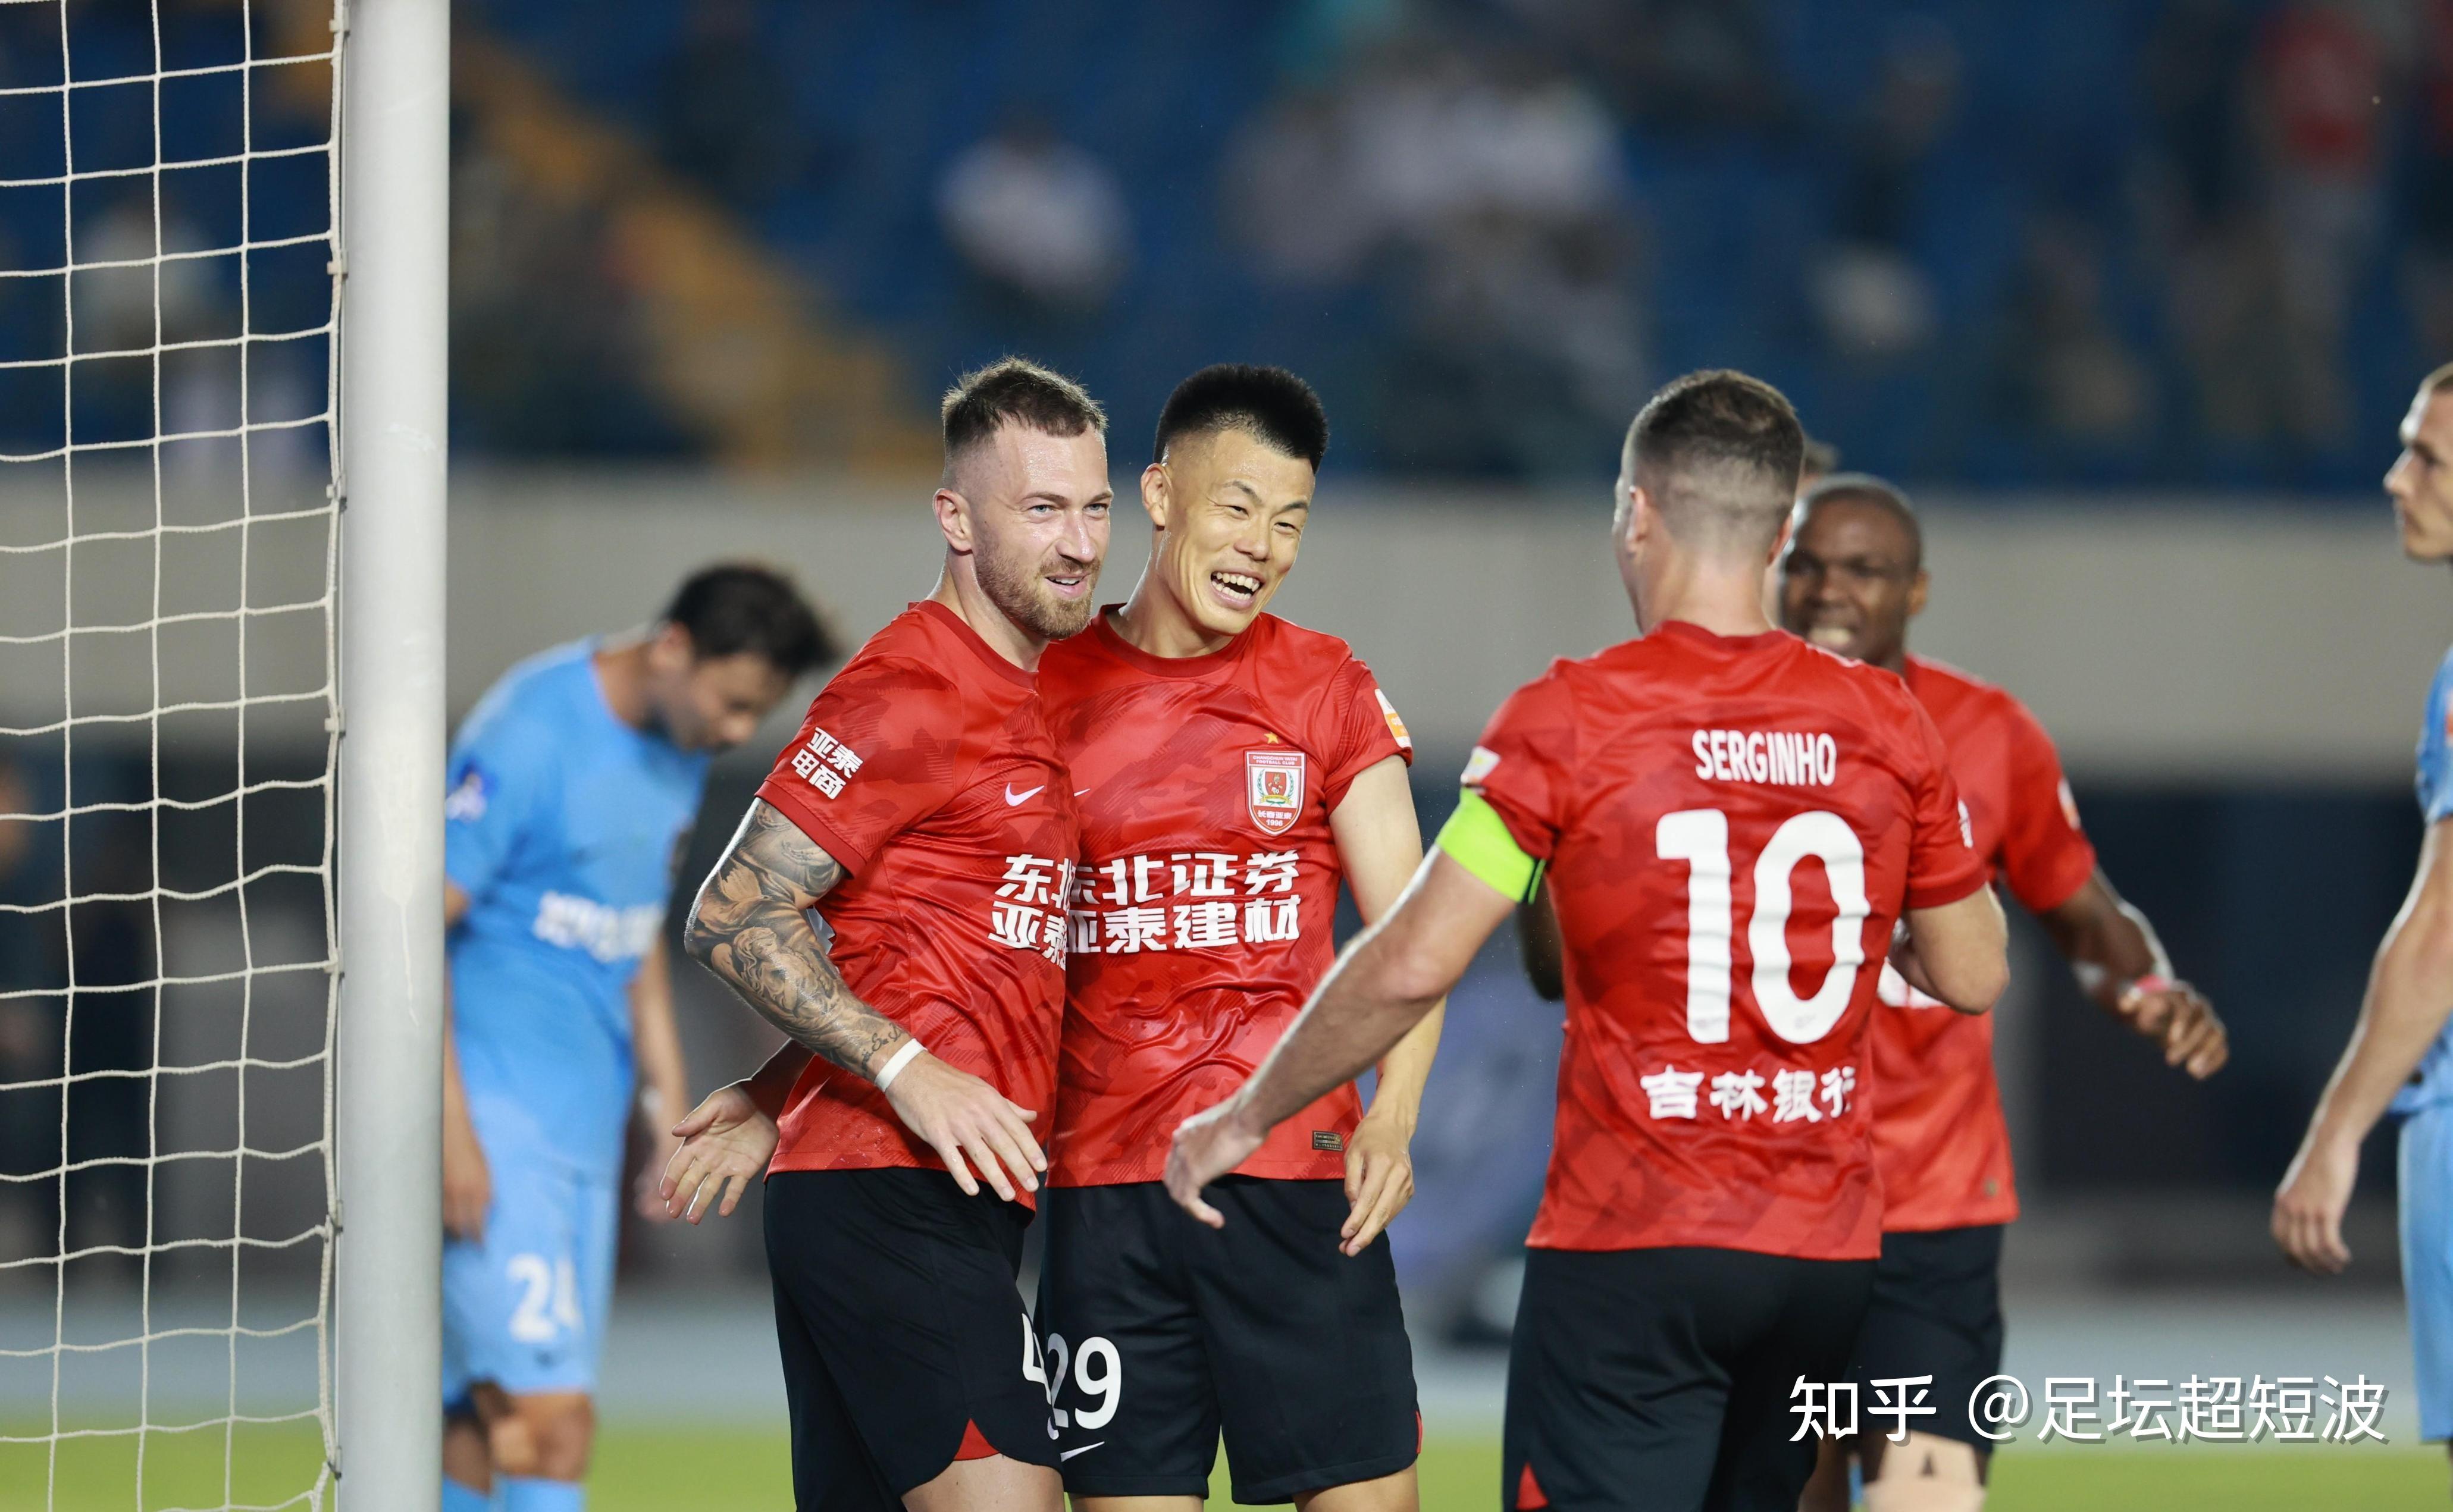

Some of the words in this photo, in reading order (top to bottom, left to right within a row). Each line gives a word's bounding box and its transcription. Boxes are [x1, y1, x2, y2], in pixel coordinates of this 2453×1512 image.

[791, 748, 847, 800] 电商
[806, 726, 864, 779] 亚泰
[1691, 729, 1837, 786] SERGINHO
[1066, 893, 1302, 953] 亚泰建材
[1656, 808, 1871, 1044] 10
[1047, 1332, 1121, 1429] 29
